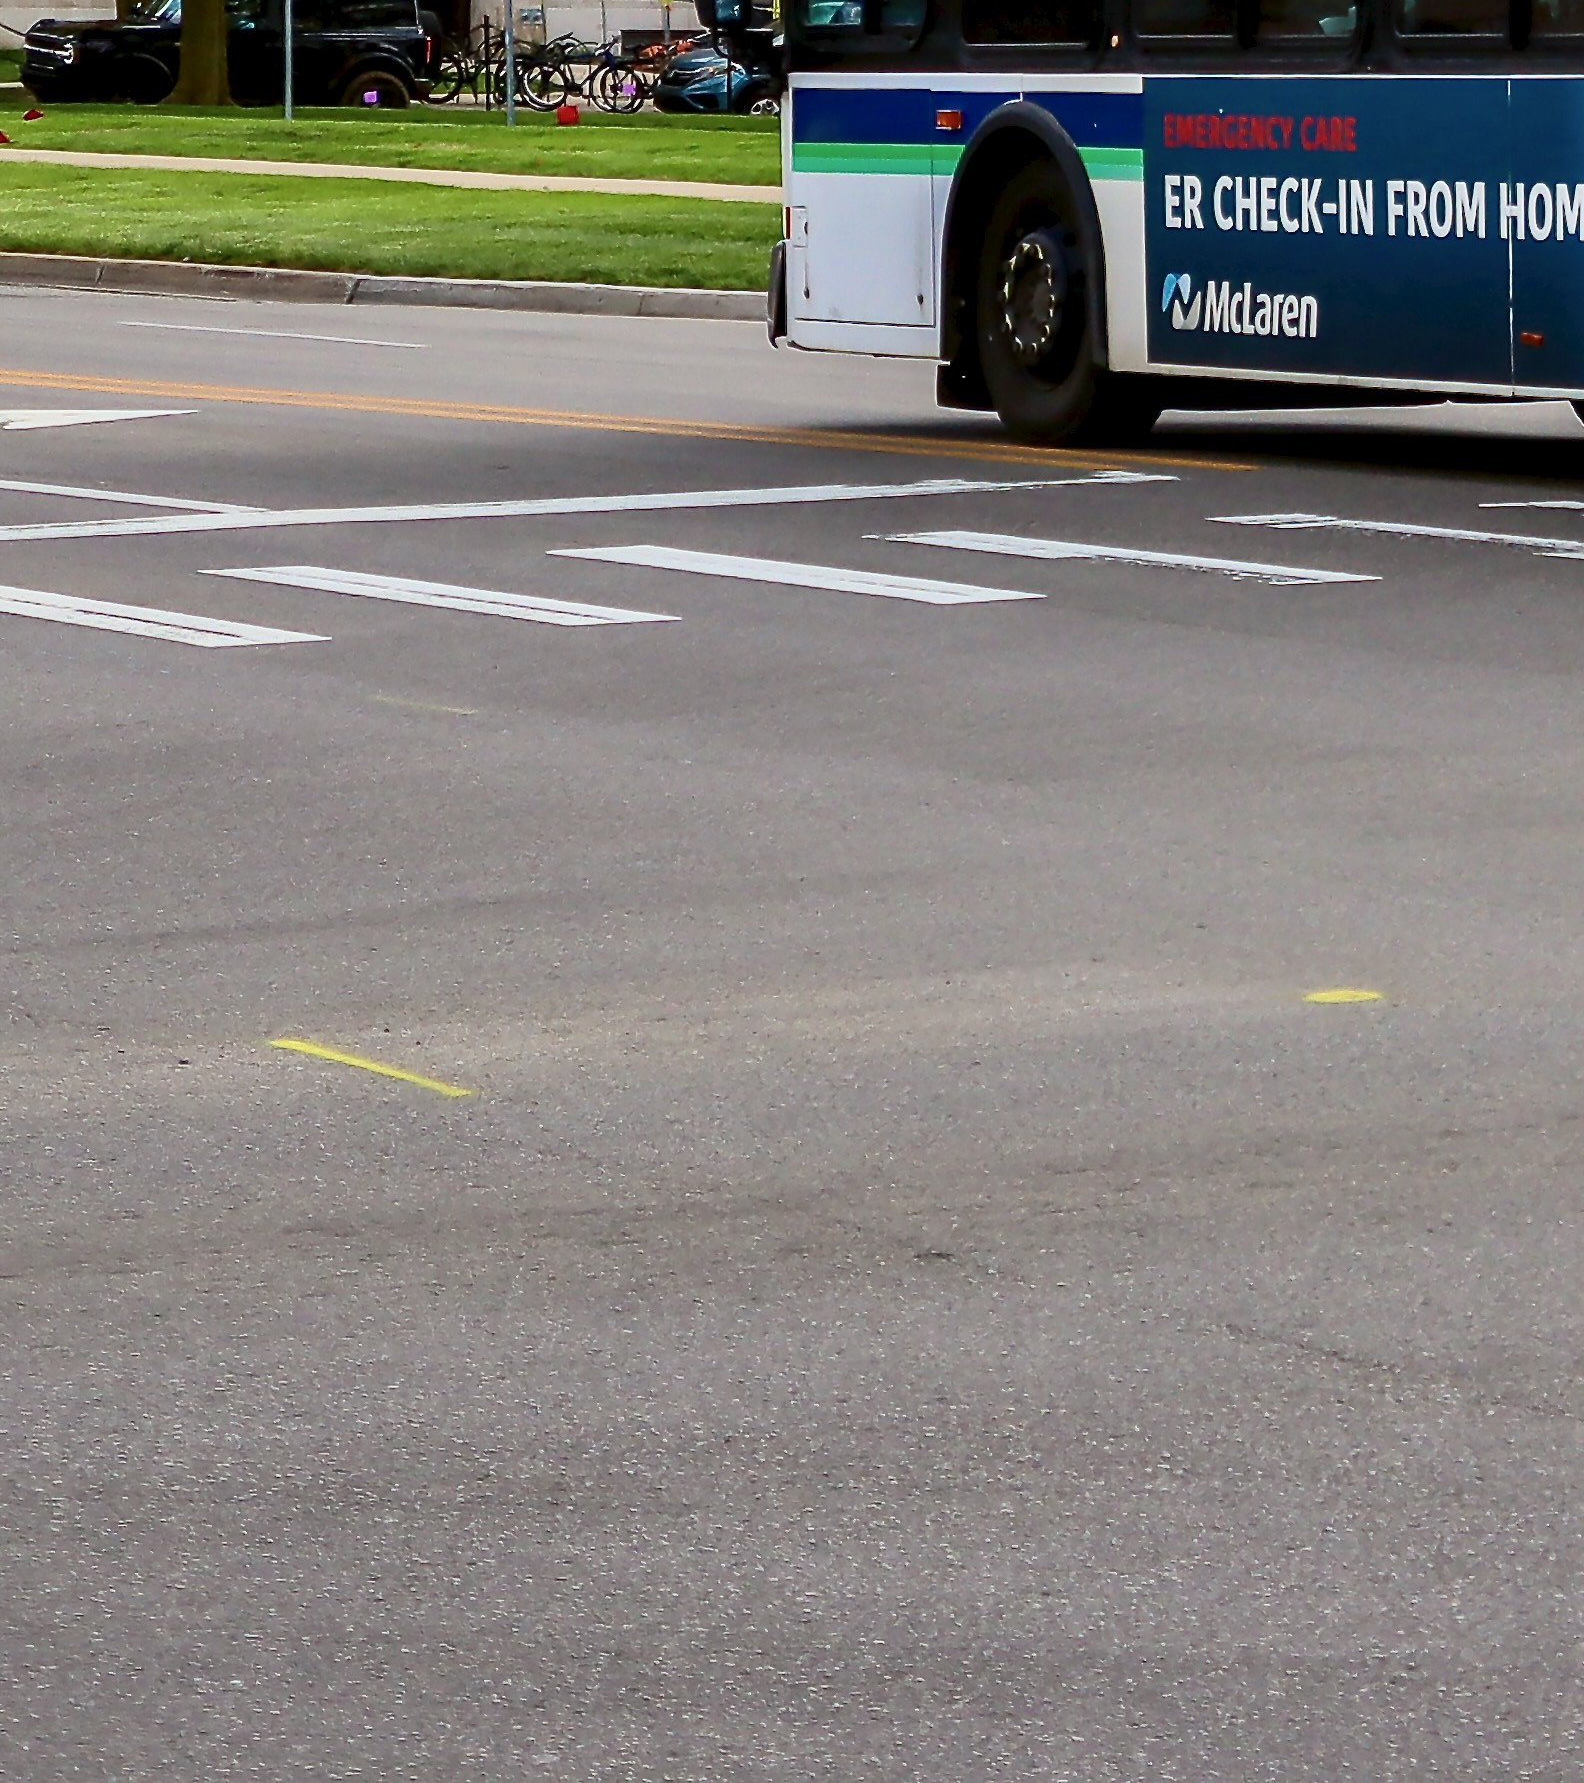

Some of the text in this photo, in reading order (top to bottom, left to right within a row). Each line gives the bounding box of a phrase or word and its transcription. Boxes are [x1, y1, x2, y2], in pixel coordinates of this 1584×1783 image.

[1162, 113, 1357, 152] EMERGENCY CARE
[1164, 174, 1204, 230] ER
[1213, 175, 1374, 236] CHECK-IN
[1386, 180, 1486, 240] FROM
[1203, 280, 1318, 338] McLaren
